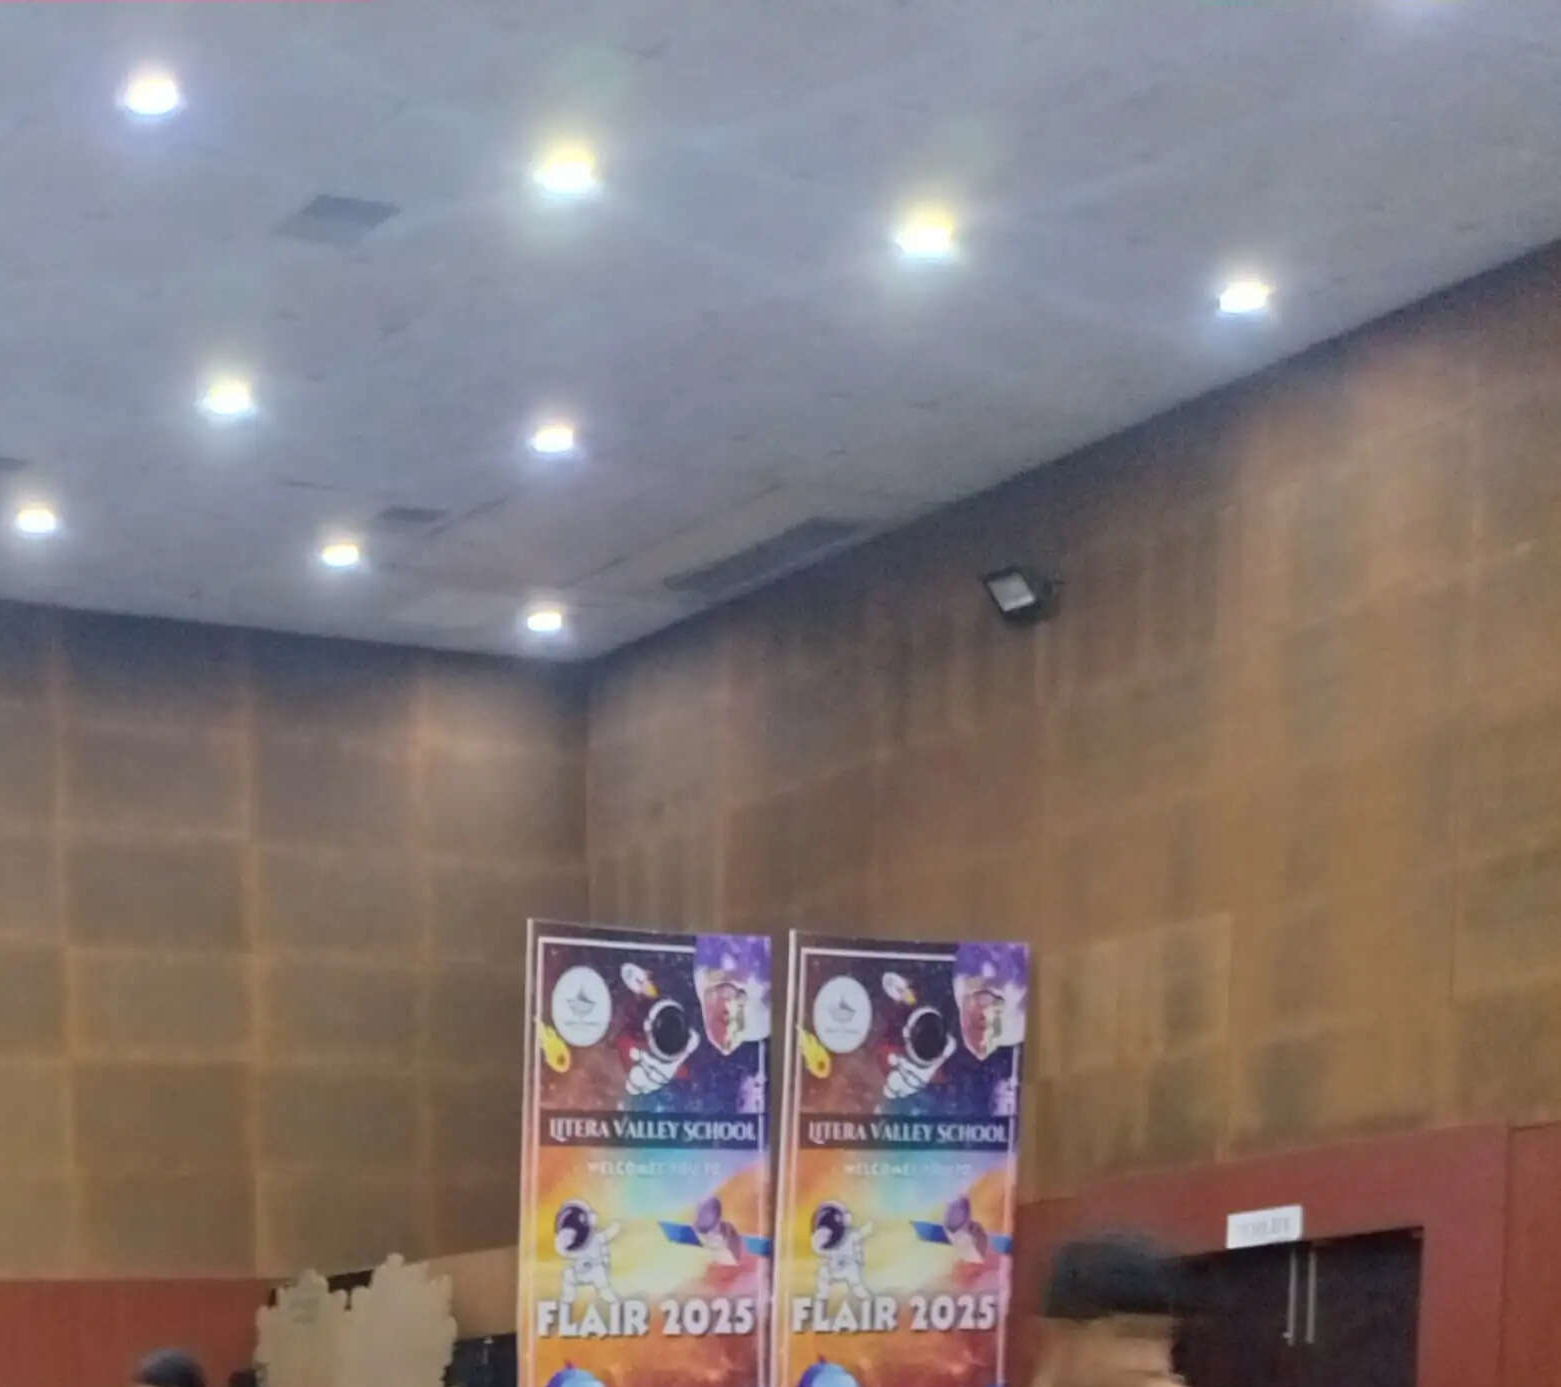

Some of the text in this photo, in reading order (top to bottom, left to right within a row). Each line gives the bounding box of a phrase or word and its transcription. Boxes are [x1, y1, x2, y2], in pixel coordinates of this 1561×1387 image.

[549, 1117, 757, 1142] LITERA VALLEY SCHOOL
[808, 1121, 1008, 1144] LITERA VALLEY SCHOOL
[539, 1300, 754, 1337] FLAIR 2025
[791, 1297, 997, 1333] FLAIR 2025
